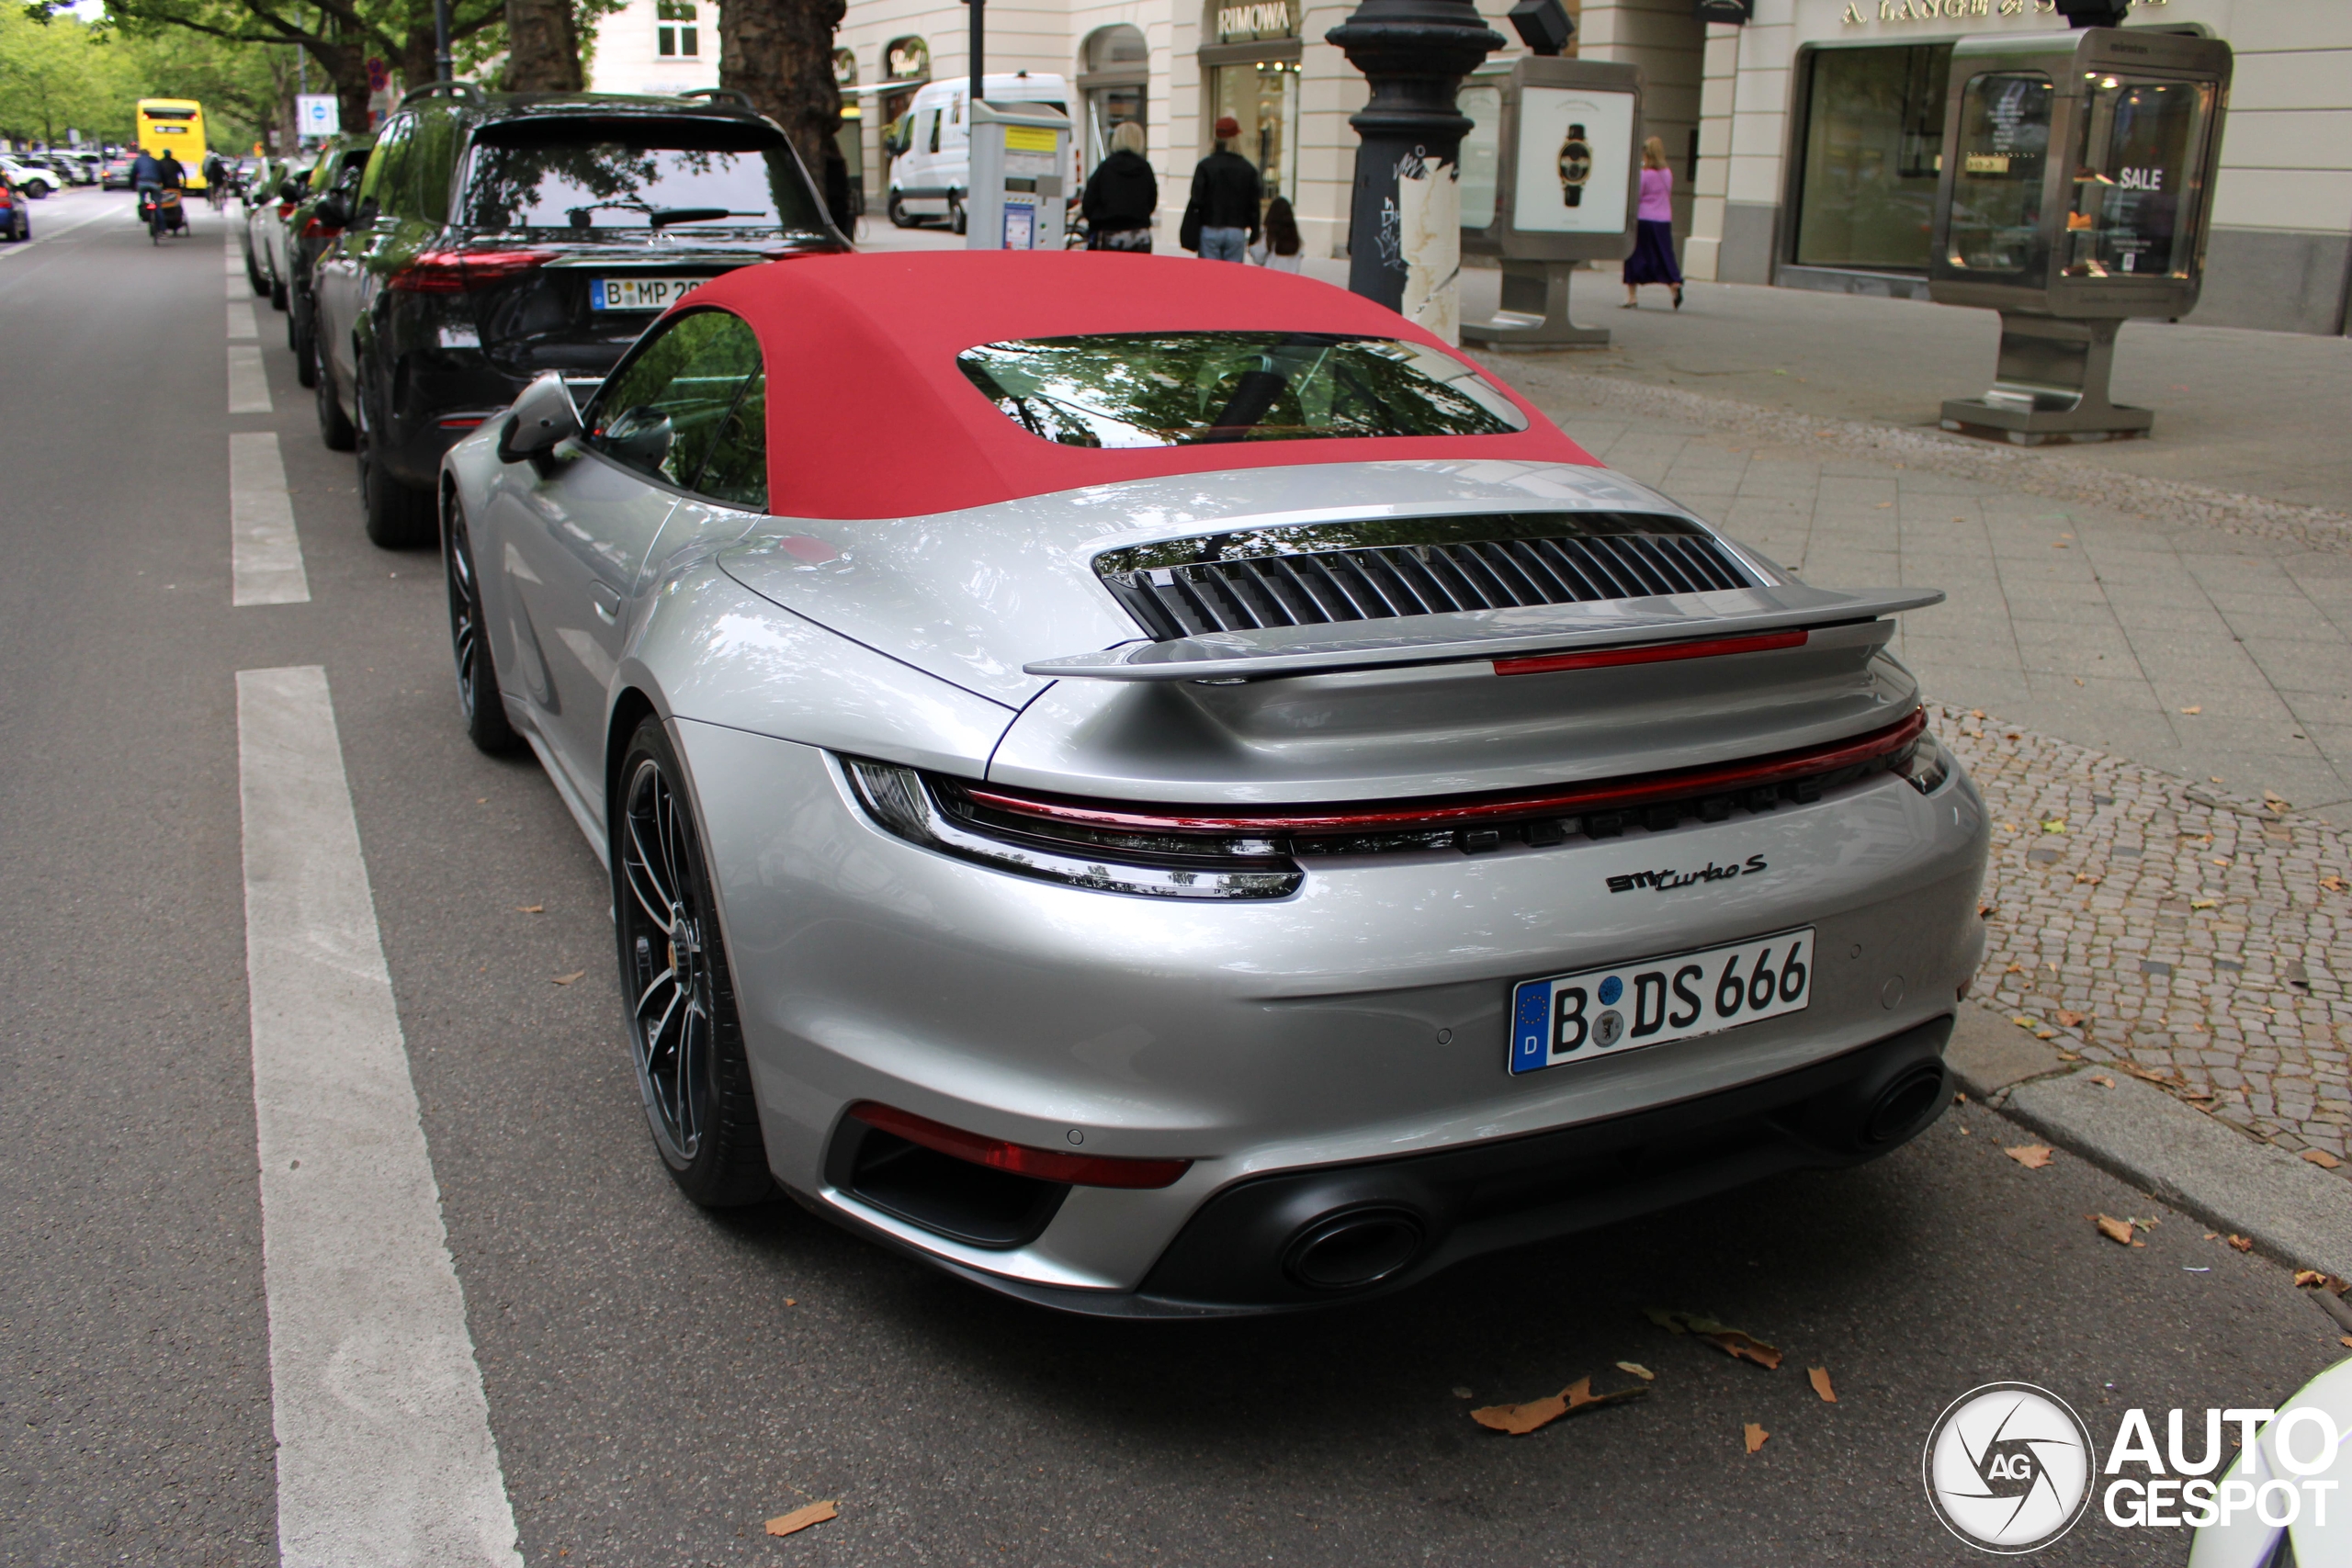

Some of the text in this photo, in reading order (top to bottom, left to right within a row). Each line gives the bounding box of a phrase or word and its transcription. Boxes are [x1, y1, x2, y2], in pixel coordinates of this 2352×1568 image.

[1218, 1, 1289, 35] RIMOWA
[1878, 0, 1988, 21] LANGE
[2120, 167, 2163, 190] SALE
[607, 282, 621, 304] B
[638, 281, 667, 304] MP
[1606, 854, 1768, 893] 911 turbo S
[1553, 987, 1589, 1055] B
[1631, 964, 1703, 1038] DS
[1715, 942, 1806, 1018] 666
[1524, 1035, 1538, 1055] D
